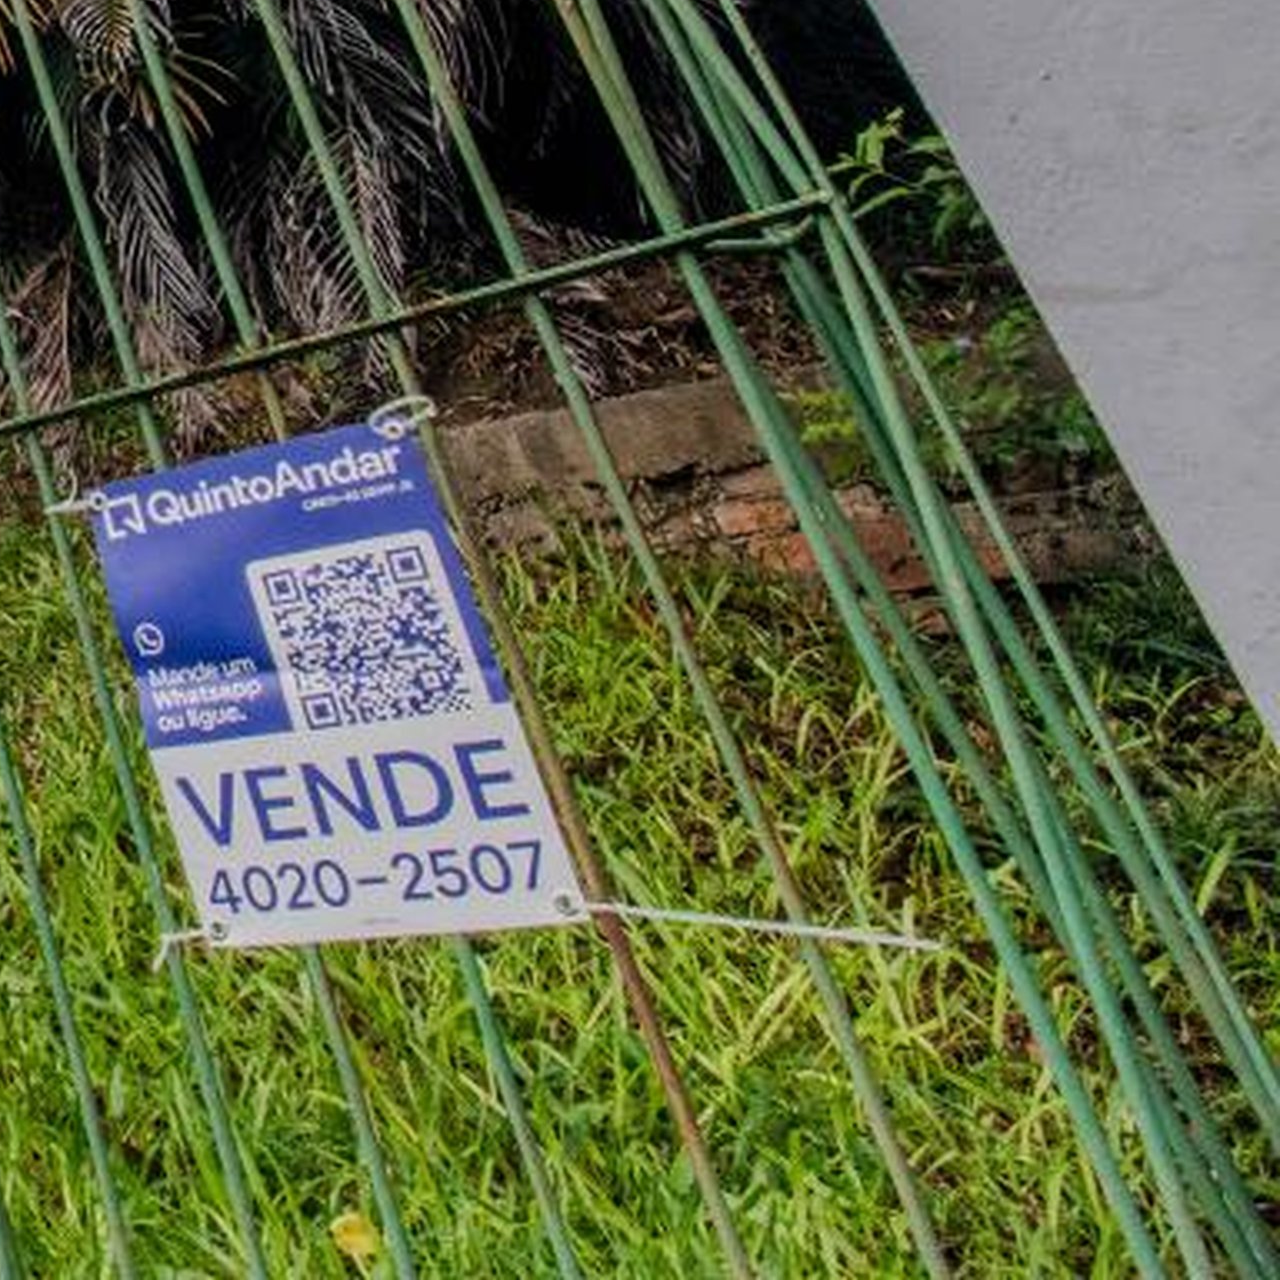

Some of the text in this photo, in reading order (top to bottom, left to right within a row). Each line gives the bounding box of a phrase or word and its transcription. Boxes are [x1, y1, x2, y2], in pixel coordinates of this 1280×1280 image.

[146, 445, 401, 525] QuintoAndar
[175, 739, 531, 847] VENDE
[209, 839, 542, 914] 4020-2507
